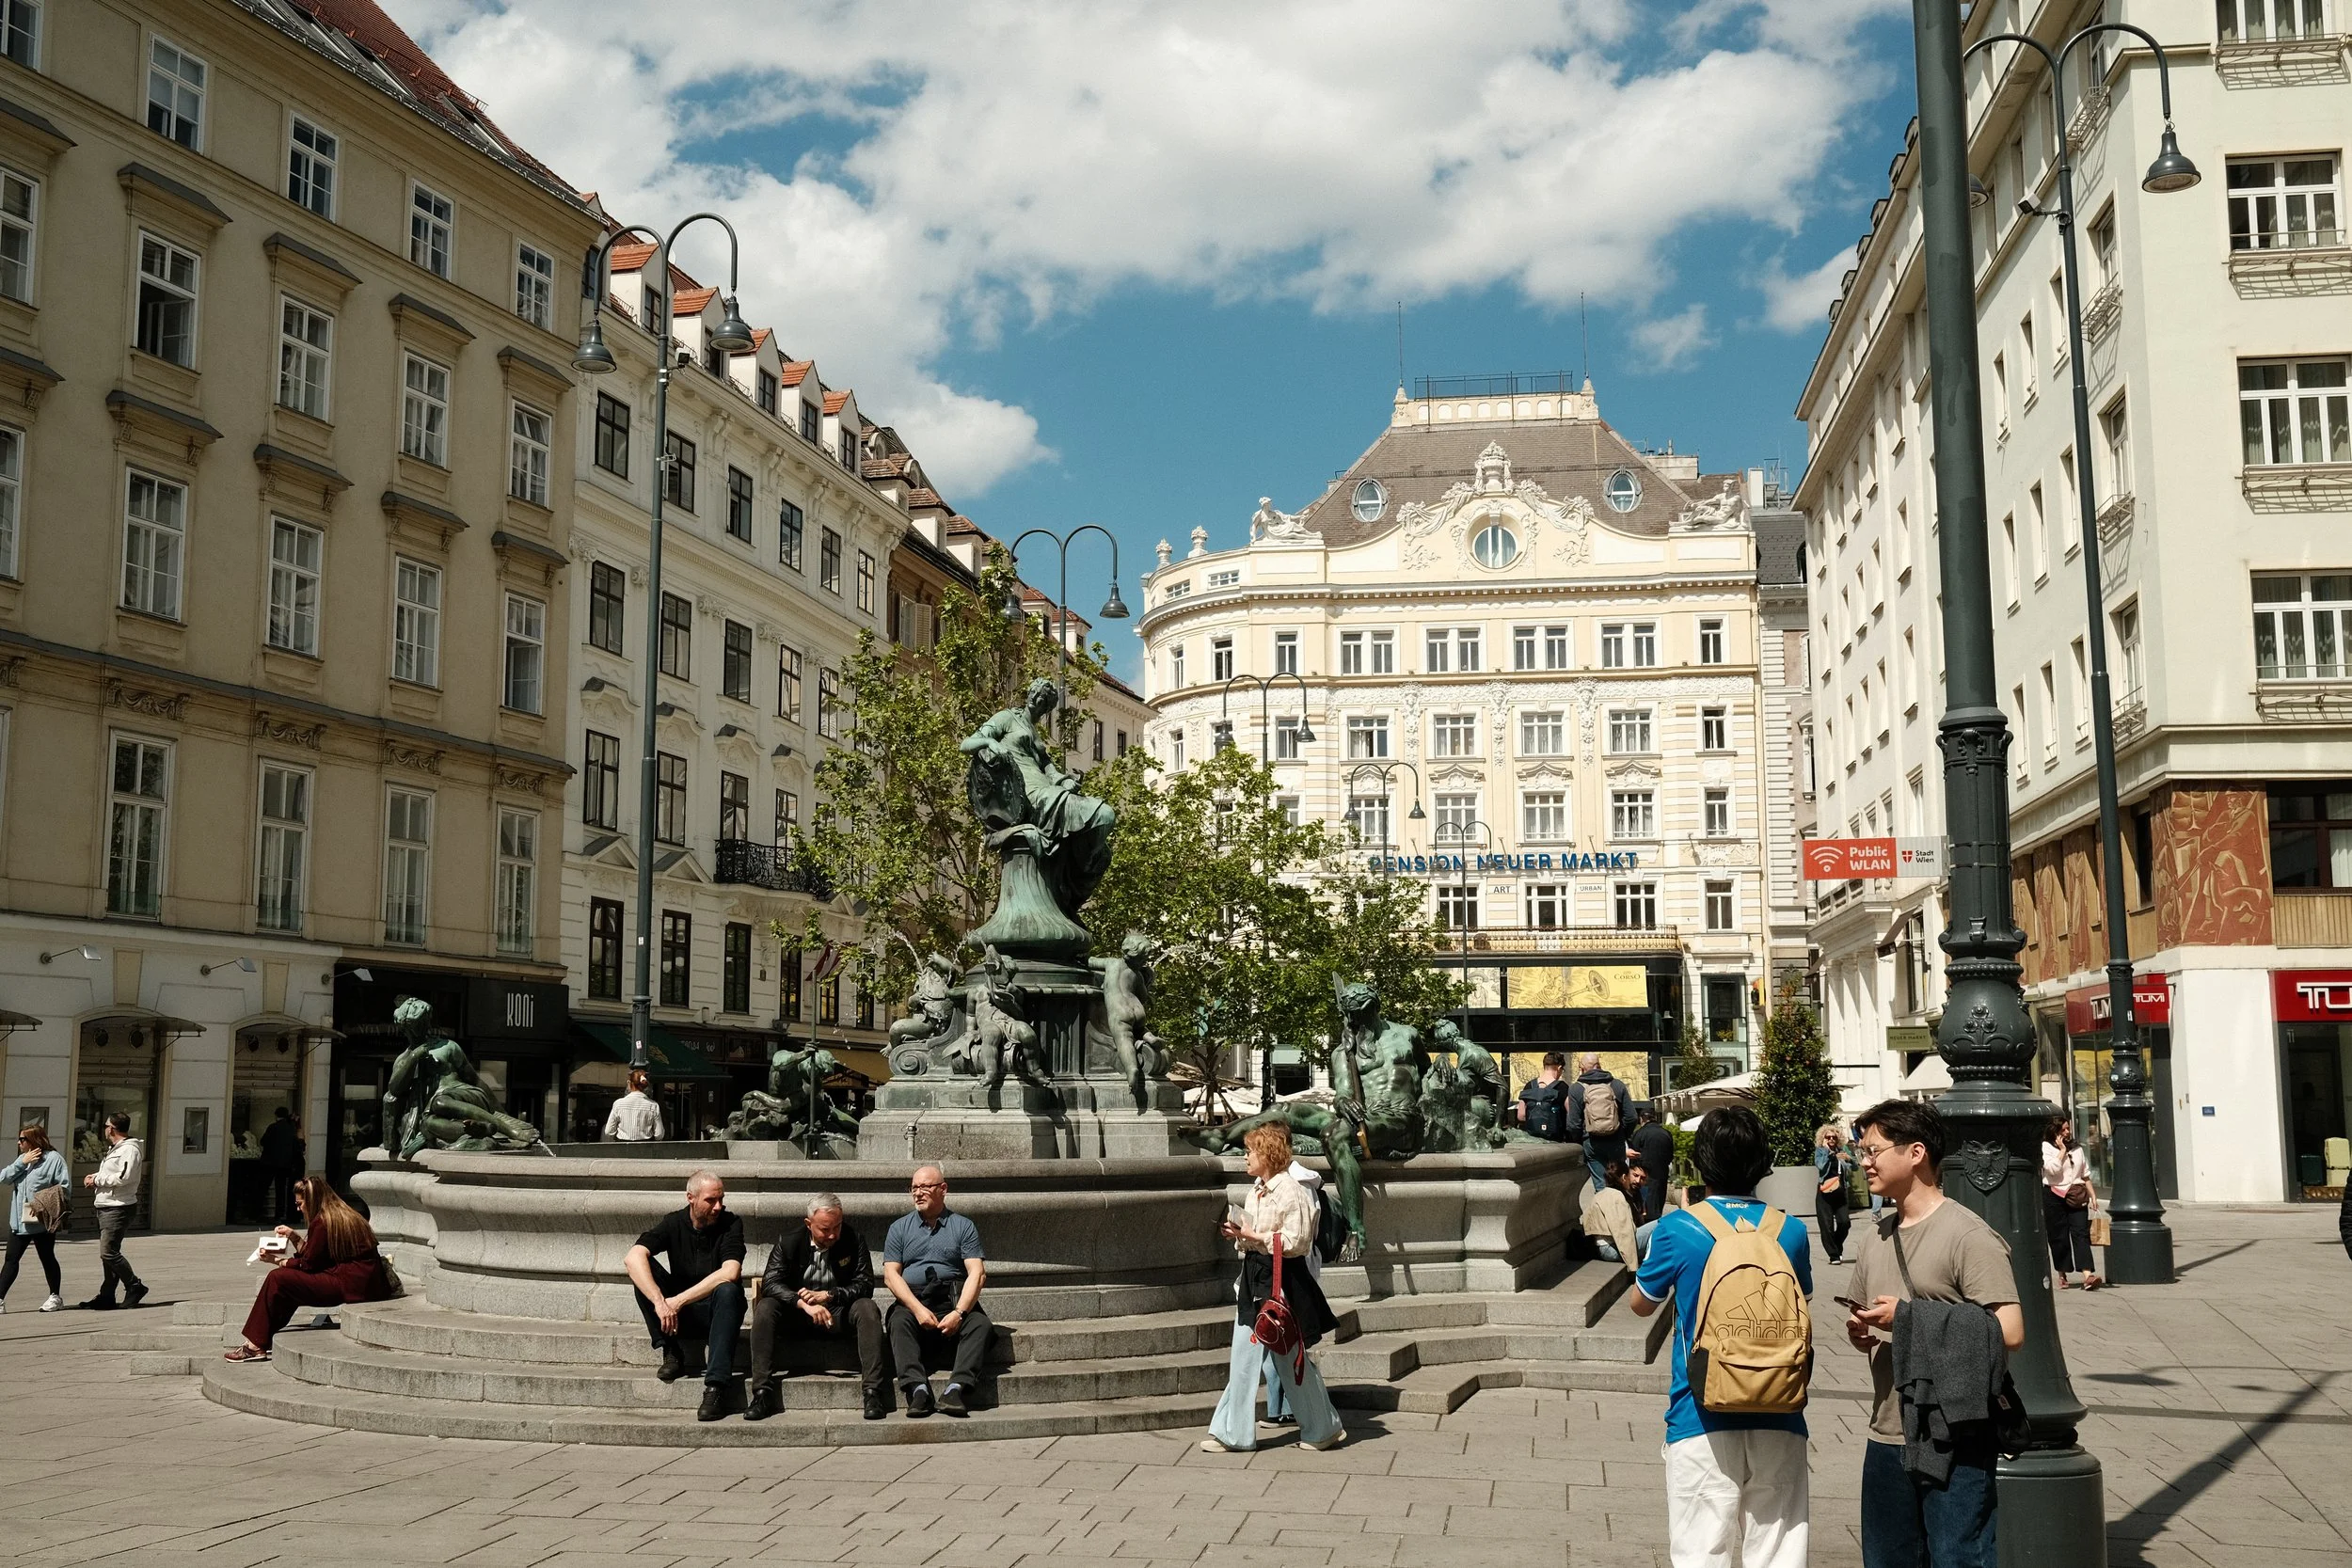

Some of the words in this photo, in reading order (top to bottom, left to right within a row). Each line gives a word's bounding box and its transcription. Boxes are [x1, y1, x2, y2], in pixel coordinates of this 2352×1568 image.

[1849, 847, 1887, 857] Public
[1476, 853, 1551, 870] NEUER
[1561, 851, 1637, 869] MARKT
[1850, 859, 1891, 870] WLAN
[2133, 993, 2165, 1003] TUMI
[2296, 982, 2352, 1008] TU
[2090, 993, 2112, 1020] TUM
